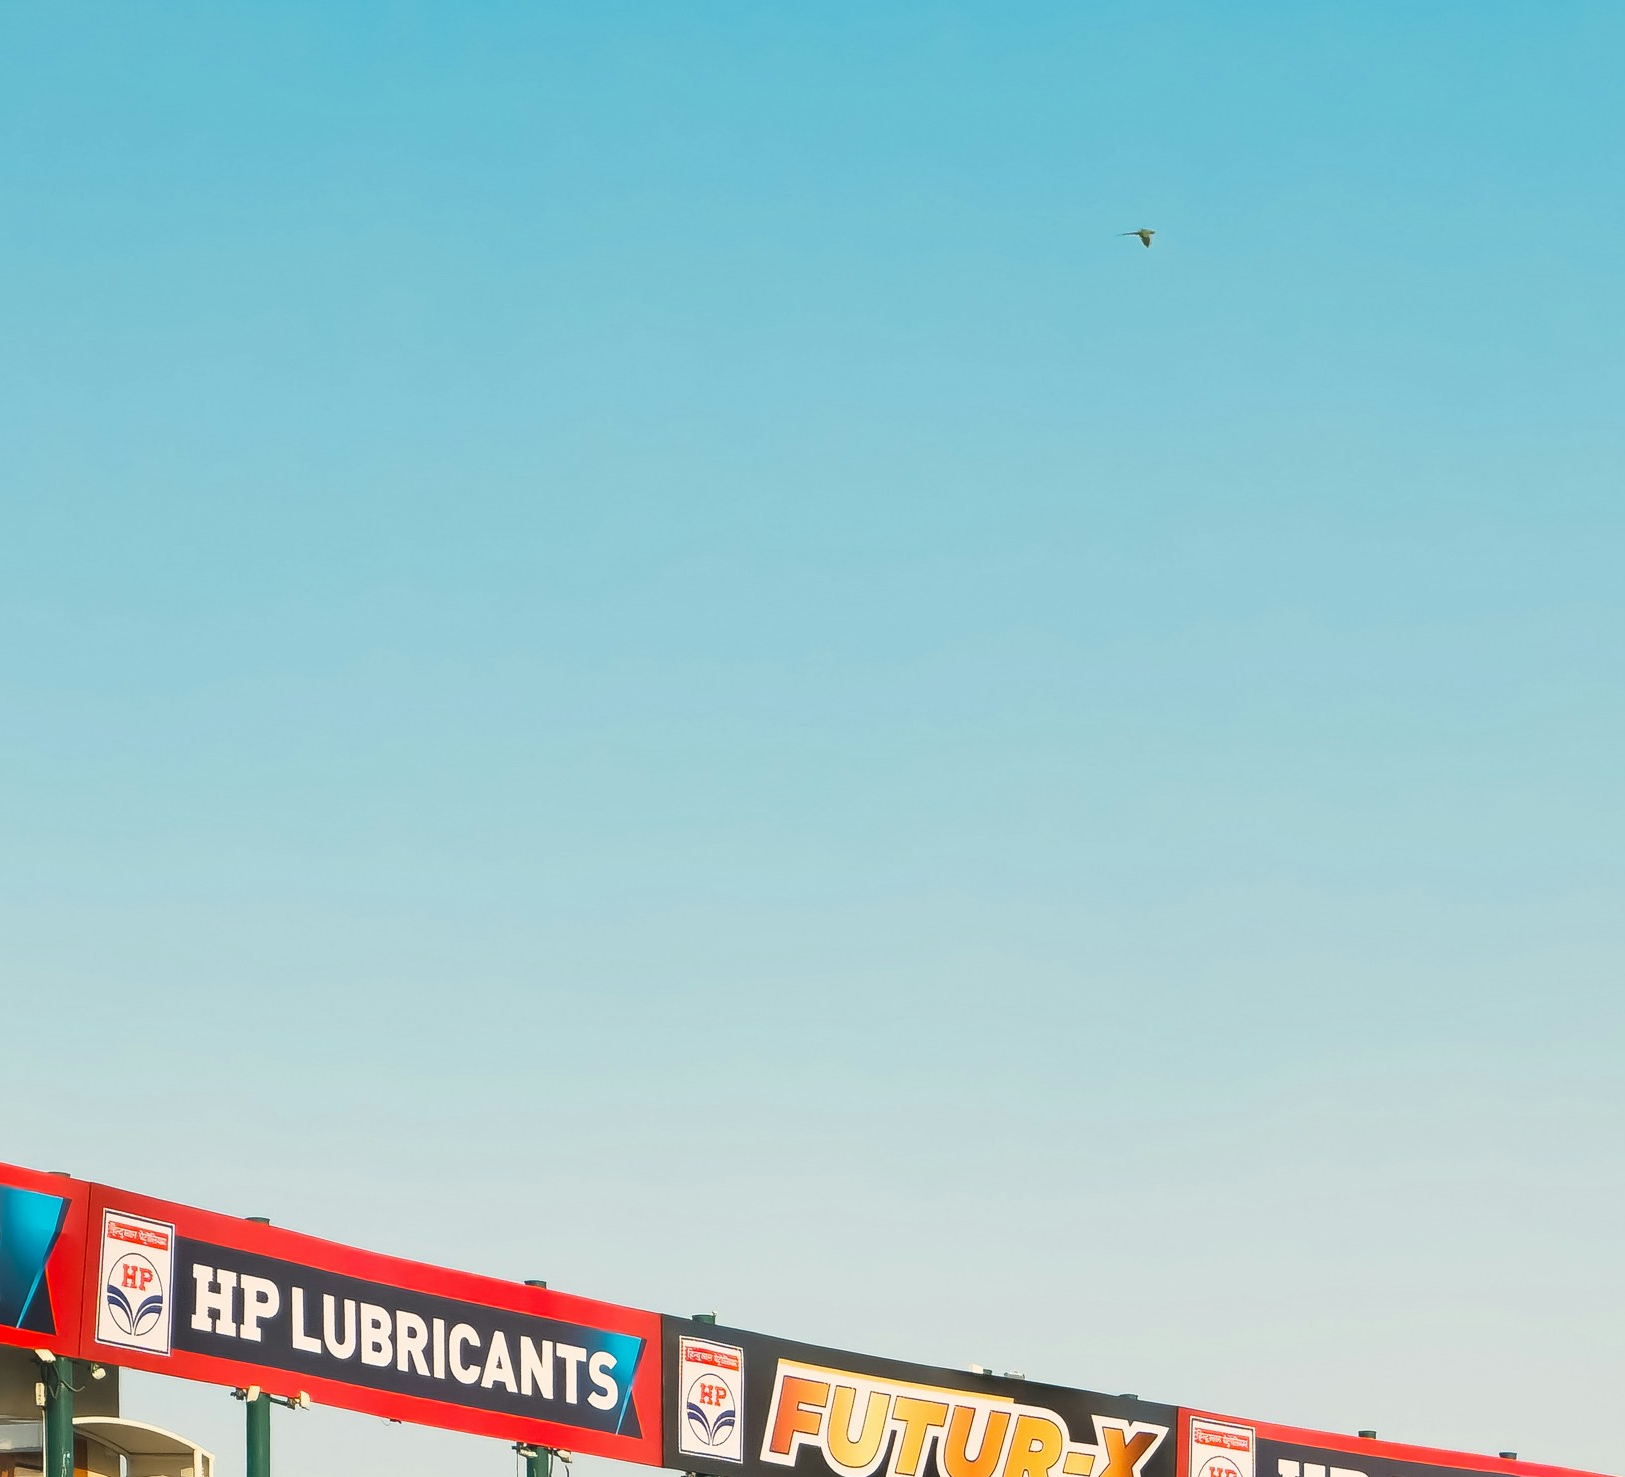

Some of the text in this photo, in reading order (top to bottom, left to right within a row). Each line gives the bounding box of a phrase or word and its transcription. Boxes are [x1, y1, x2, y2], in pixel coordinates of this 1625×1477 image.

[121, 1263, 153, 1292] HP
[191, 1264, 617, 1410] HP LUBRICANTS
[700, 1383, 727, 1407] HP
